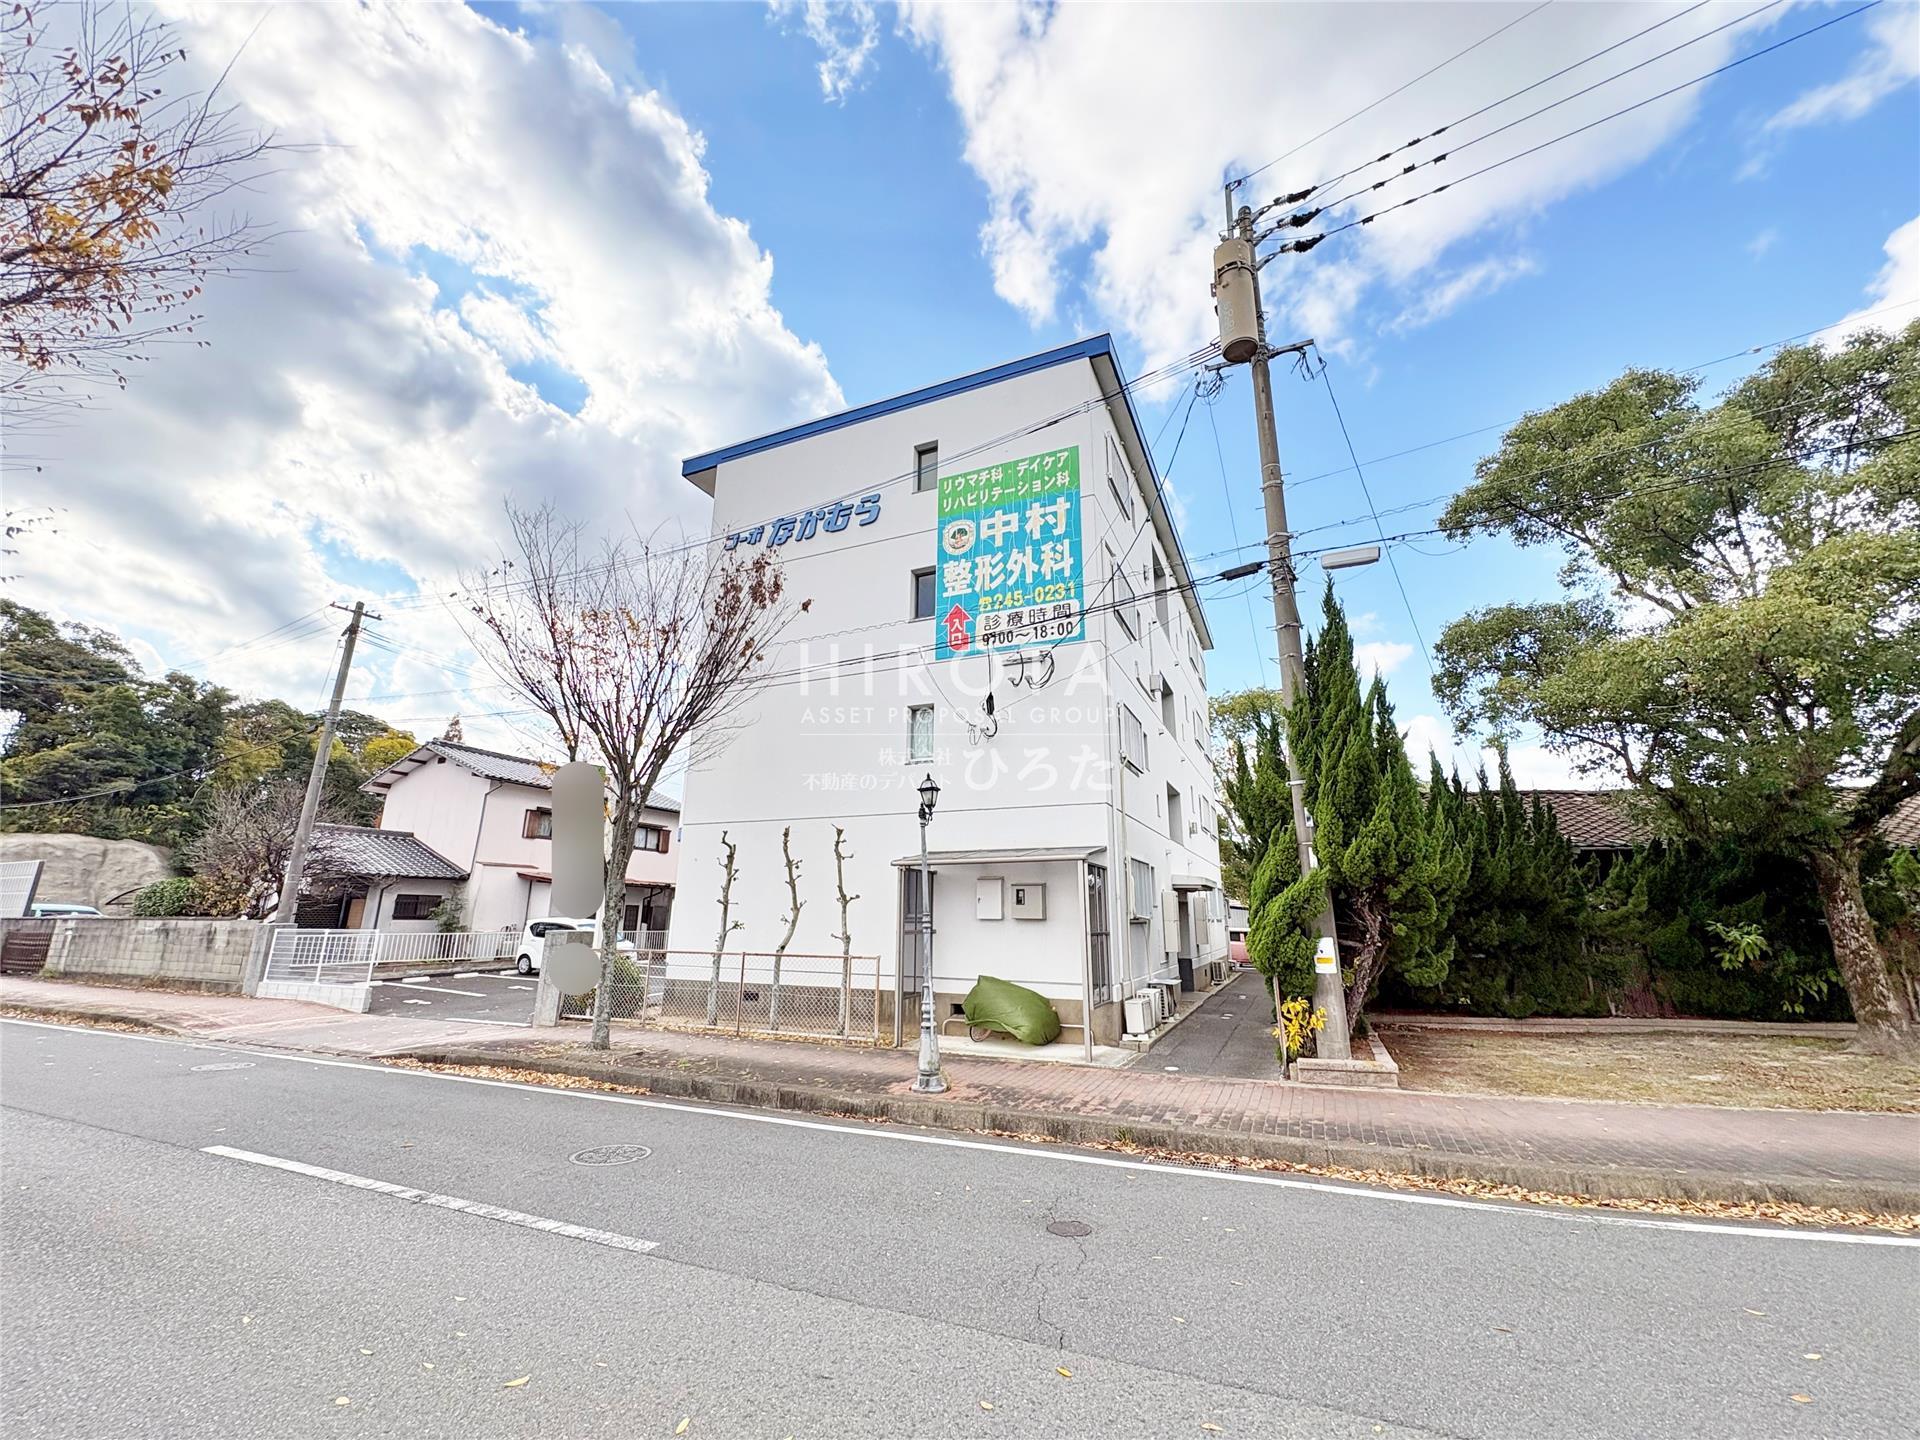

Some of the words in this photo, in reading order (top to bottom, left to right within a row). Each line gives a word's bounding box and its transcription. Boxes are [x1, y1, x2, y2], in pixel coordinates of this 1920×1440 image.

[766, 493, 881, 548] なかむら
[980, 497, 1071, 547] 中村
[942, 539, 1074, 598] 整形外科
[950, 618, 962, 646] 入口
[984, 604, 1072, 631] 診療時間
